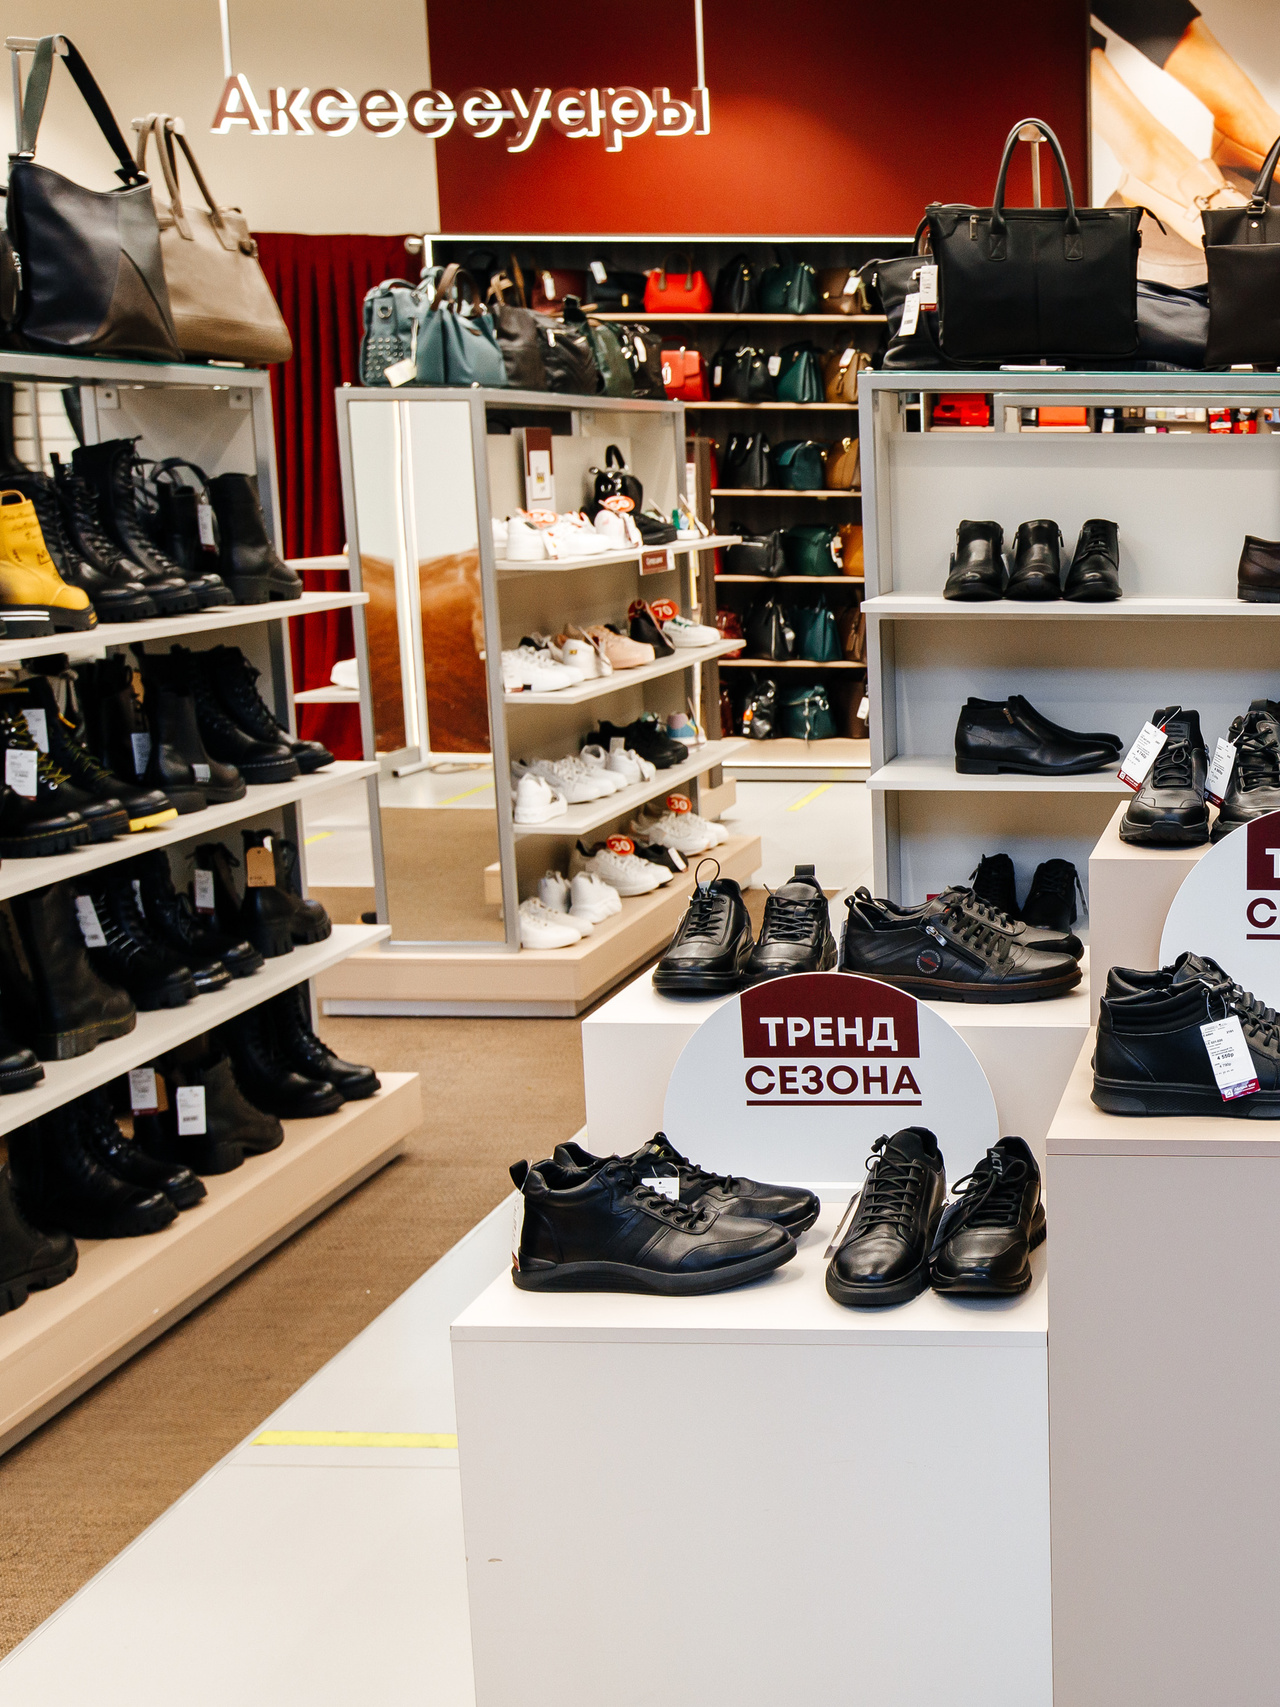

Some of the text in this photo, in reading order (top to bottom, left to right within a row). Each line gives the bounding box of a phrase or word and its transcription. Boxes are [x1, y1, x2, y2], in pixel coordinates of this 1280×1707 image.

[210, 72, 710, 153] Аксессуары
[654, 605, 673, 618] 70
[670, 798, 688, 810] 30
[611, 840, 631, 852] 30
[760, 1016, 898, 1051] ТРЕНД
[745, 1065, 922, 1095] СЕЗОНА
